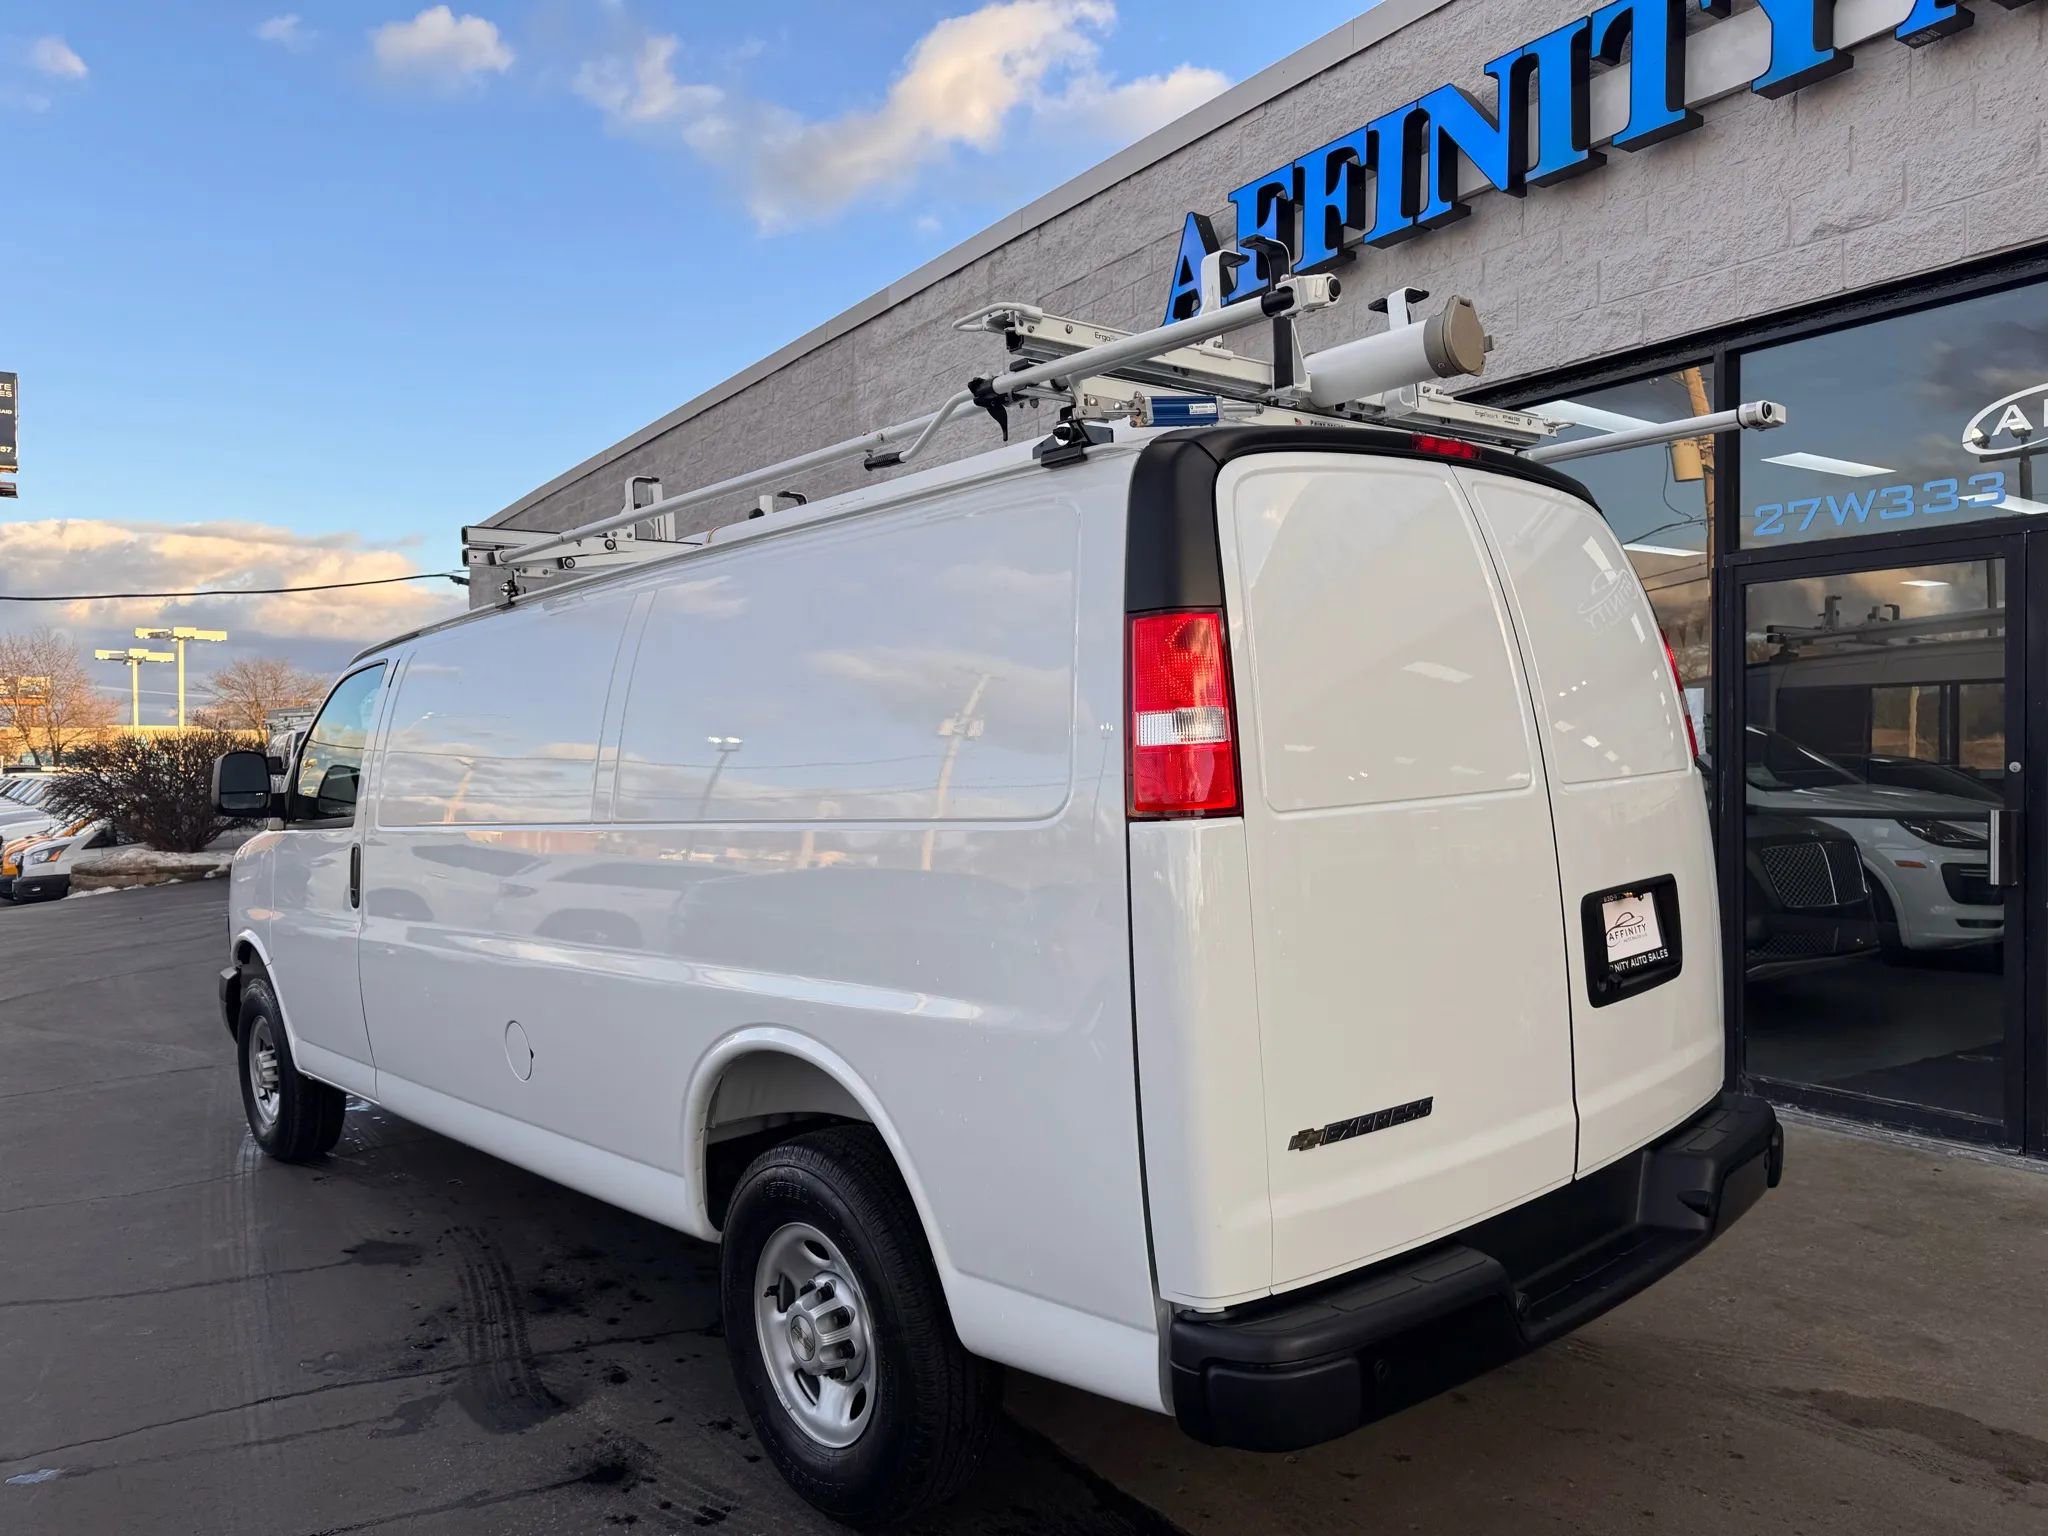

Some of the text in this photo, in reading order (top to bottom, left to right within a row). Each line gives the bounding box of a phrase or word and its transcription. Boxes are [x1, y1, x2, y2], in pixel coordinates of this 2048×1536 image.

[1162, 0, 1854, 328] AFFINITY
[1753, 471, 2006, 537] 27W333
[1608, 923, 1647, 942] AFFINITY
[1630, 954, 1648, 968] AUTO
[1647, 948, 1669, 963] SALES
[1320, 1096, 1434, 1147] EXPRESS
